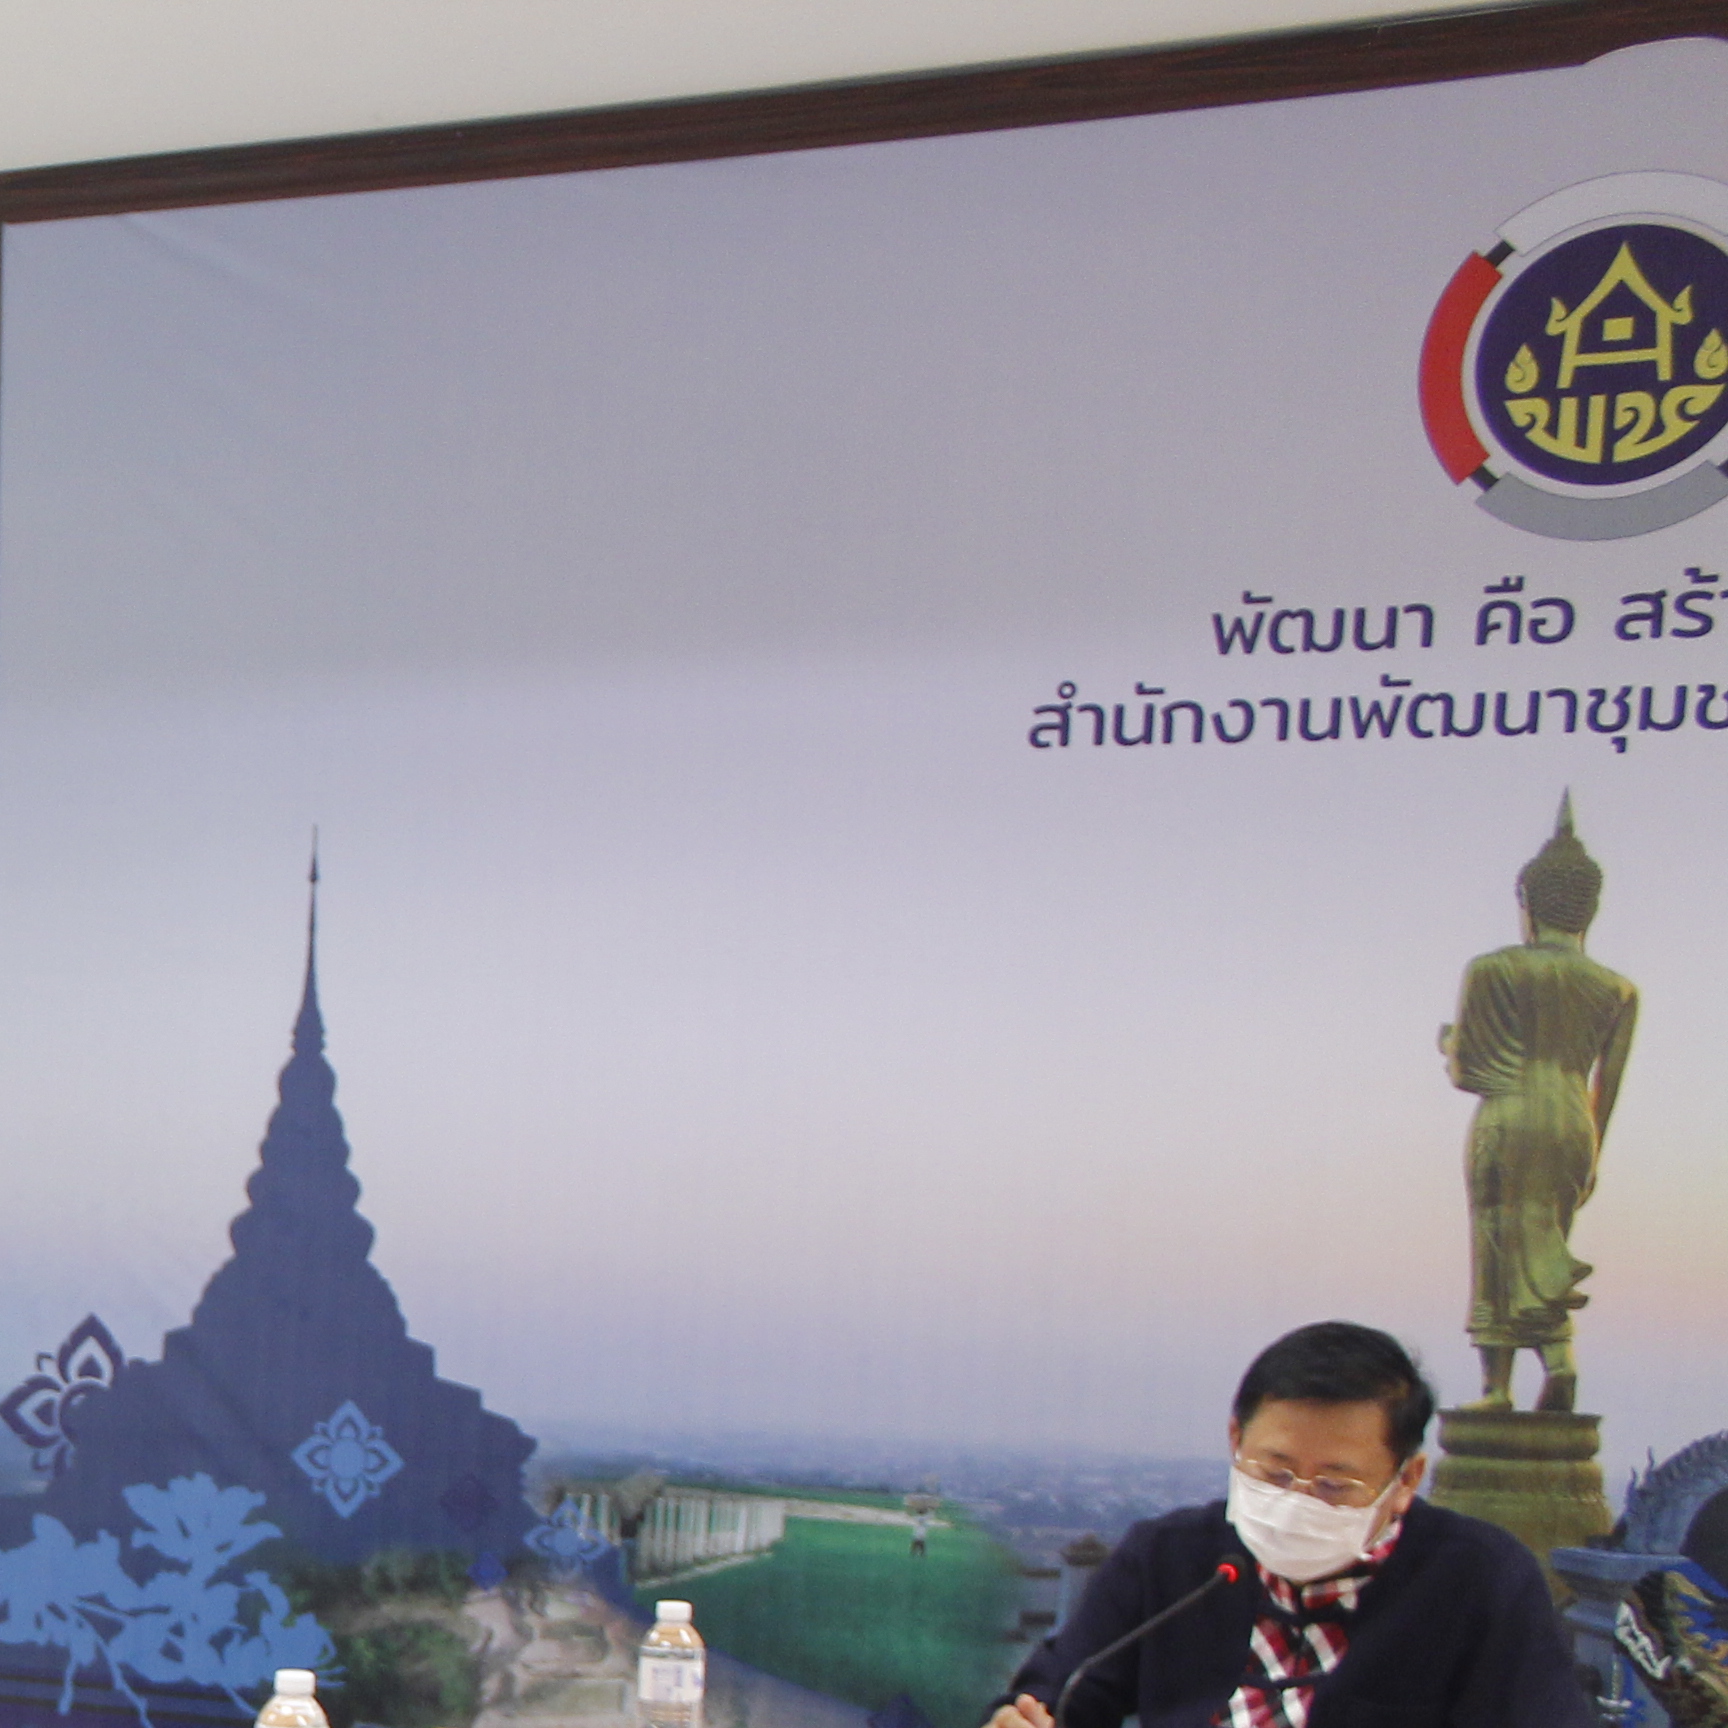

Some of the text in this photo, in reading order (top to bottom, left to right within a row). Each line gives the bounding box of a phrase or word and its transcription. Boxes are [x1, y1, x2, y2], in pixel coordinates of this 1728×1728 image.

[1213, 566, 1728, 656] พัฒนา คือ สร้
